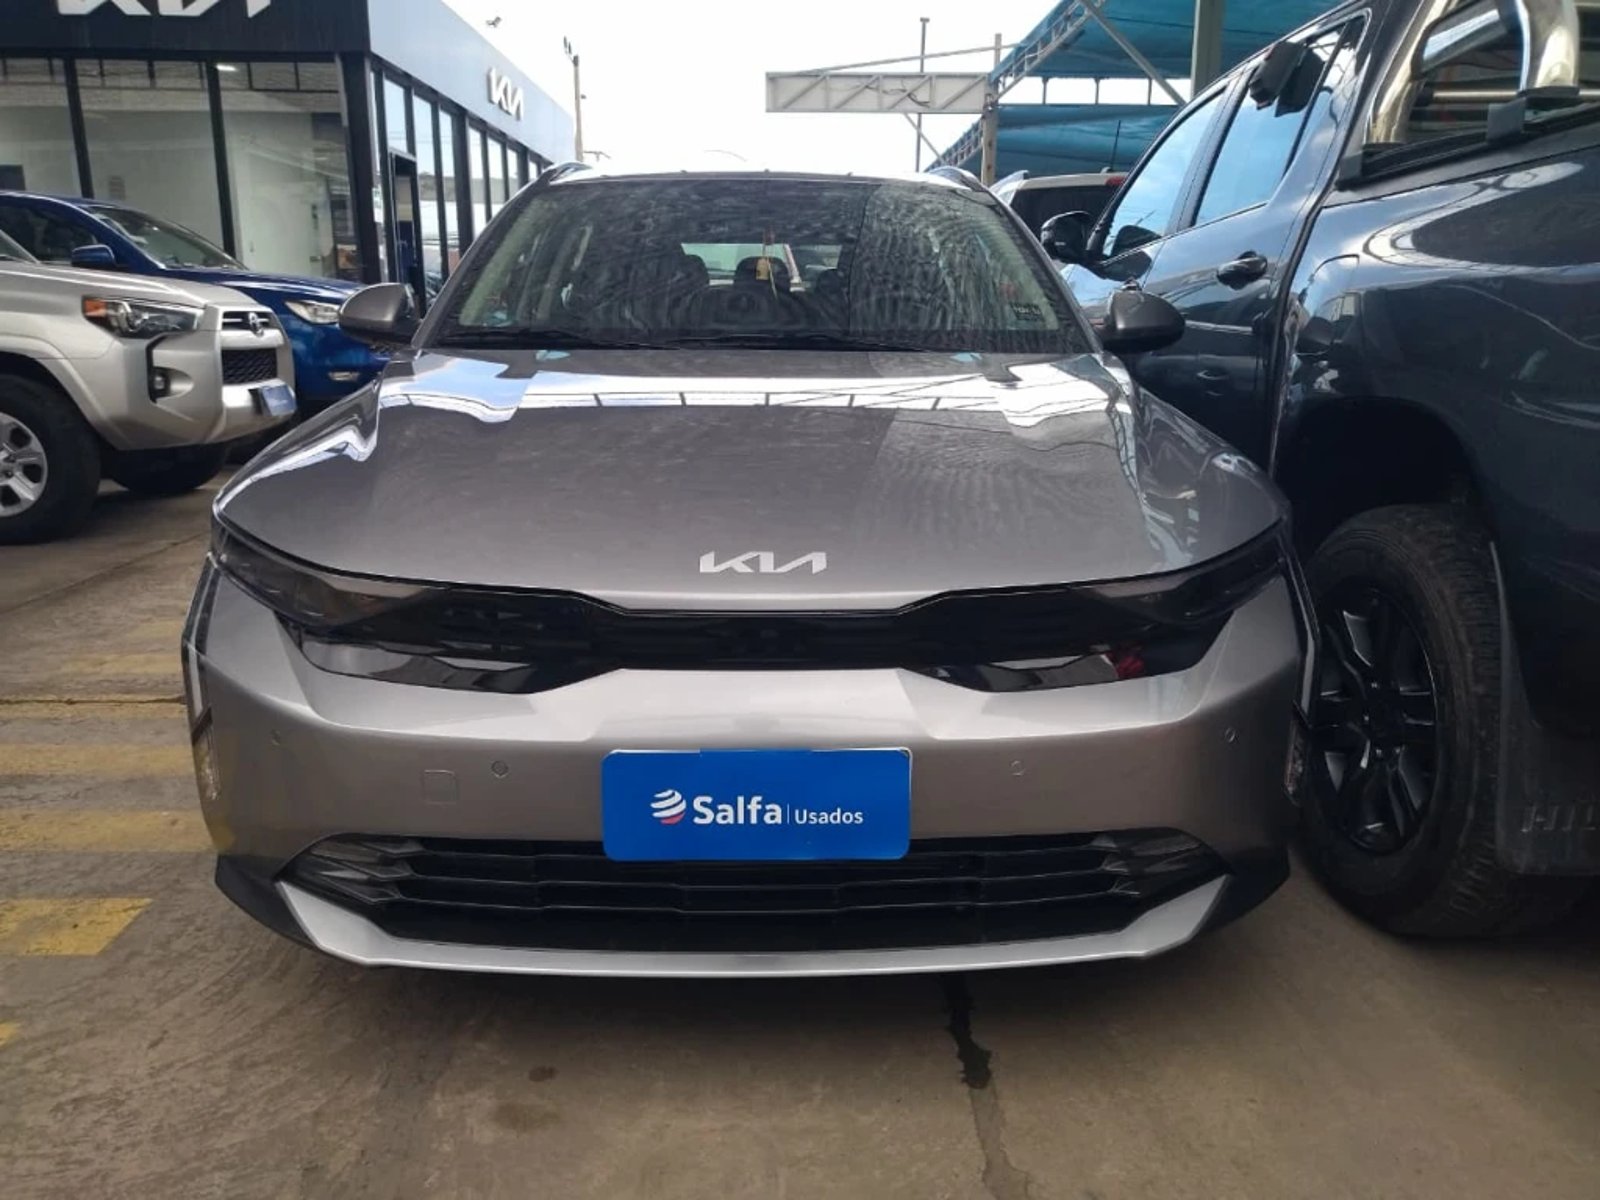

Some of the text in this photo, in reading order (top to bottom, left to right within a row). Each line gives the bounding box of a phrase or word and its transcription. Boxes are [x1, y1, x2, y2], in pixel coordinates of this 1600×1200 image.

[487, 68, 524, 121] KIA
[699, 551, 827, 574] KIA
[692, 795, 864, 825] Salfa Usados
